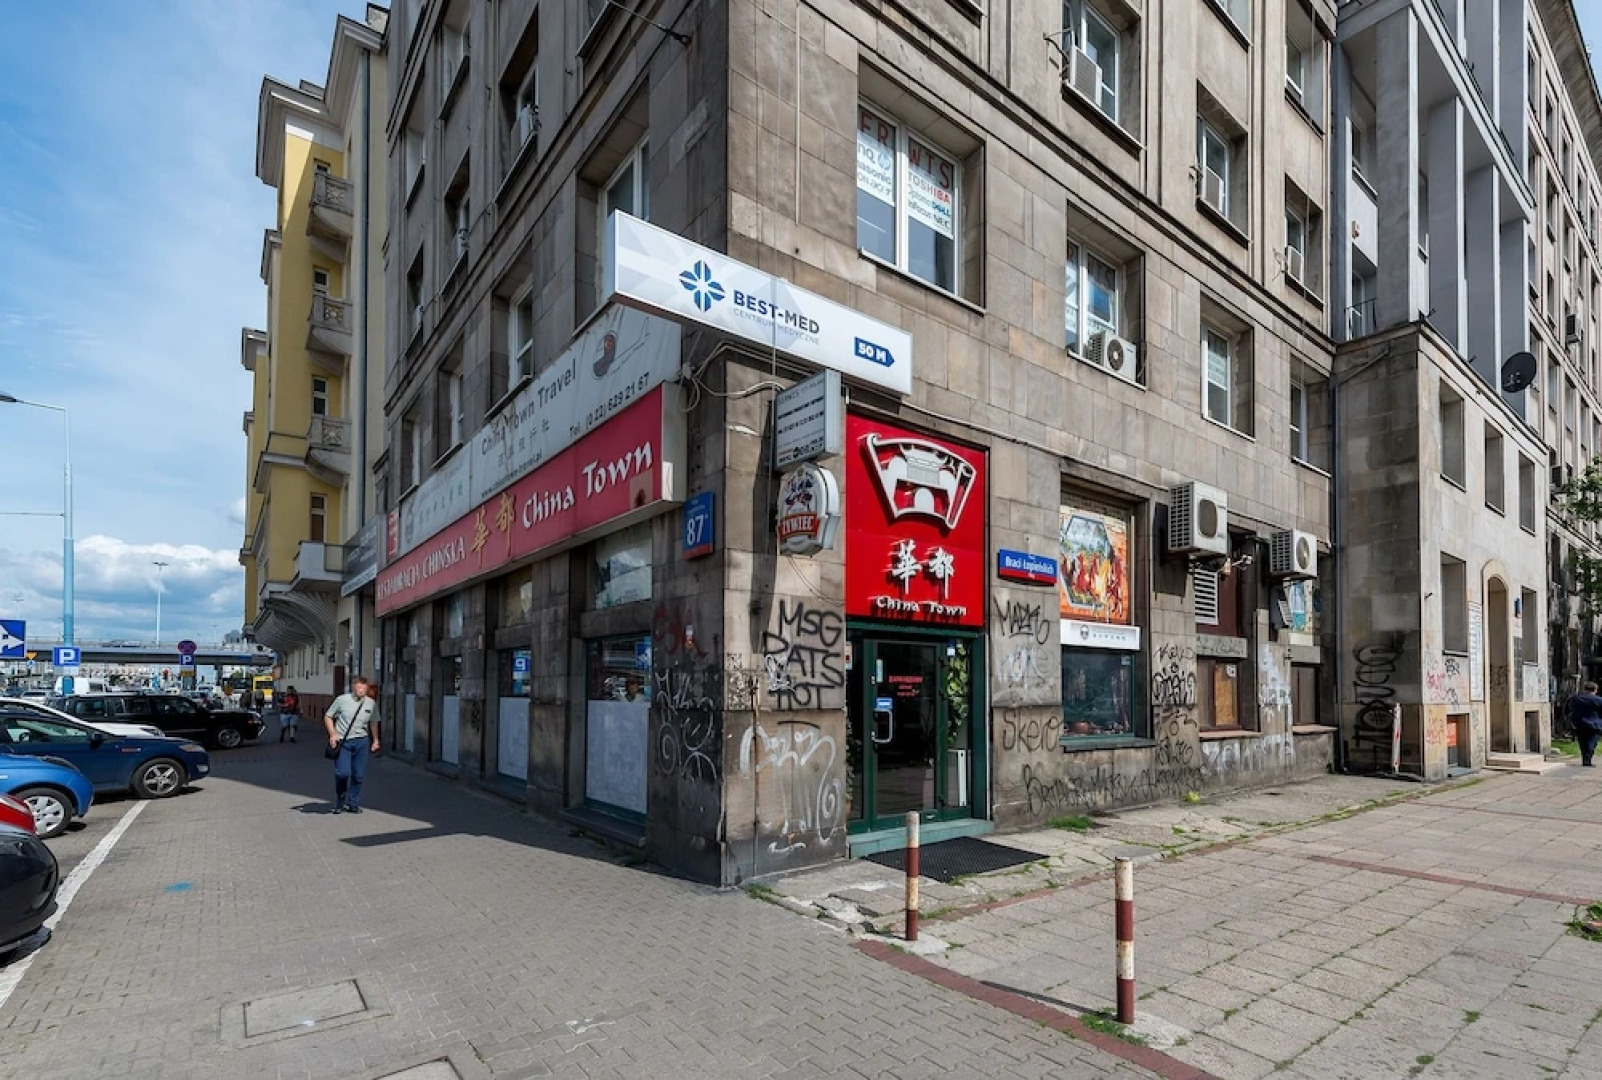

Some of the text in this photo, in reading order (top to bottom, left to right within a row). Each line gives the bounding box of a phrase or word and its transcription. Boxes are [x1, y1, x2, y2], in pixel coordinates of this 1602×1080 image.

[909, 170, 950, 206] TOSHIBA
[733, 290, 820, 334] BEST-MED
[733, 308, 820, 346] CENTRUM MEDYCZNE
[858, 342, 887, 362] 50 M
[537, 359, 576, 408] Travel
[522, 485, 576, 529] China
[582, 440, 653, 498] Town
[892, 539, 956, 600] 華都
[779, 599, 843, 647] MSG
[876, 595, 967, 616] China Town
[59, 649, 75, 664] P
